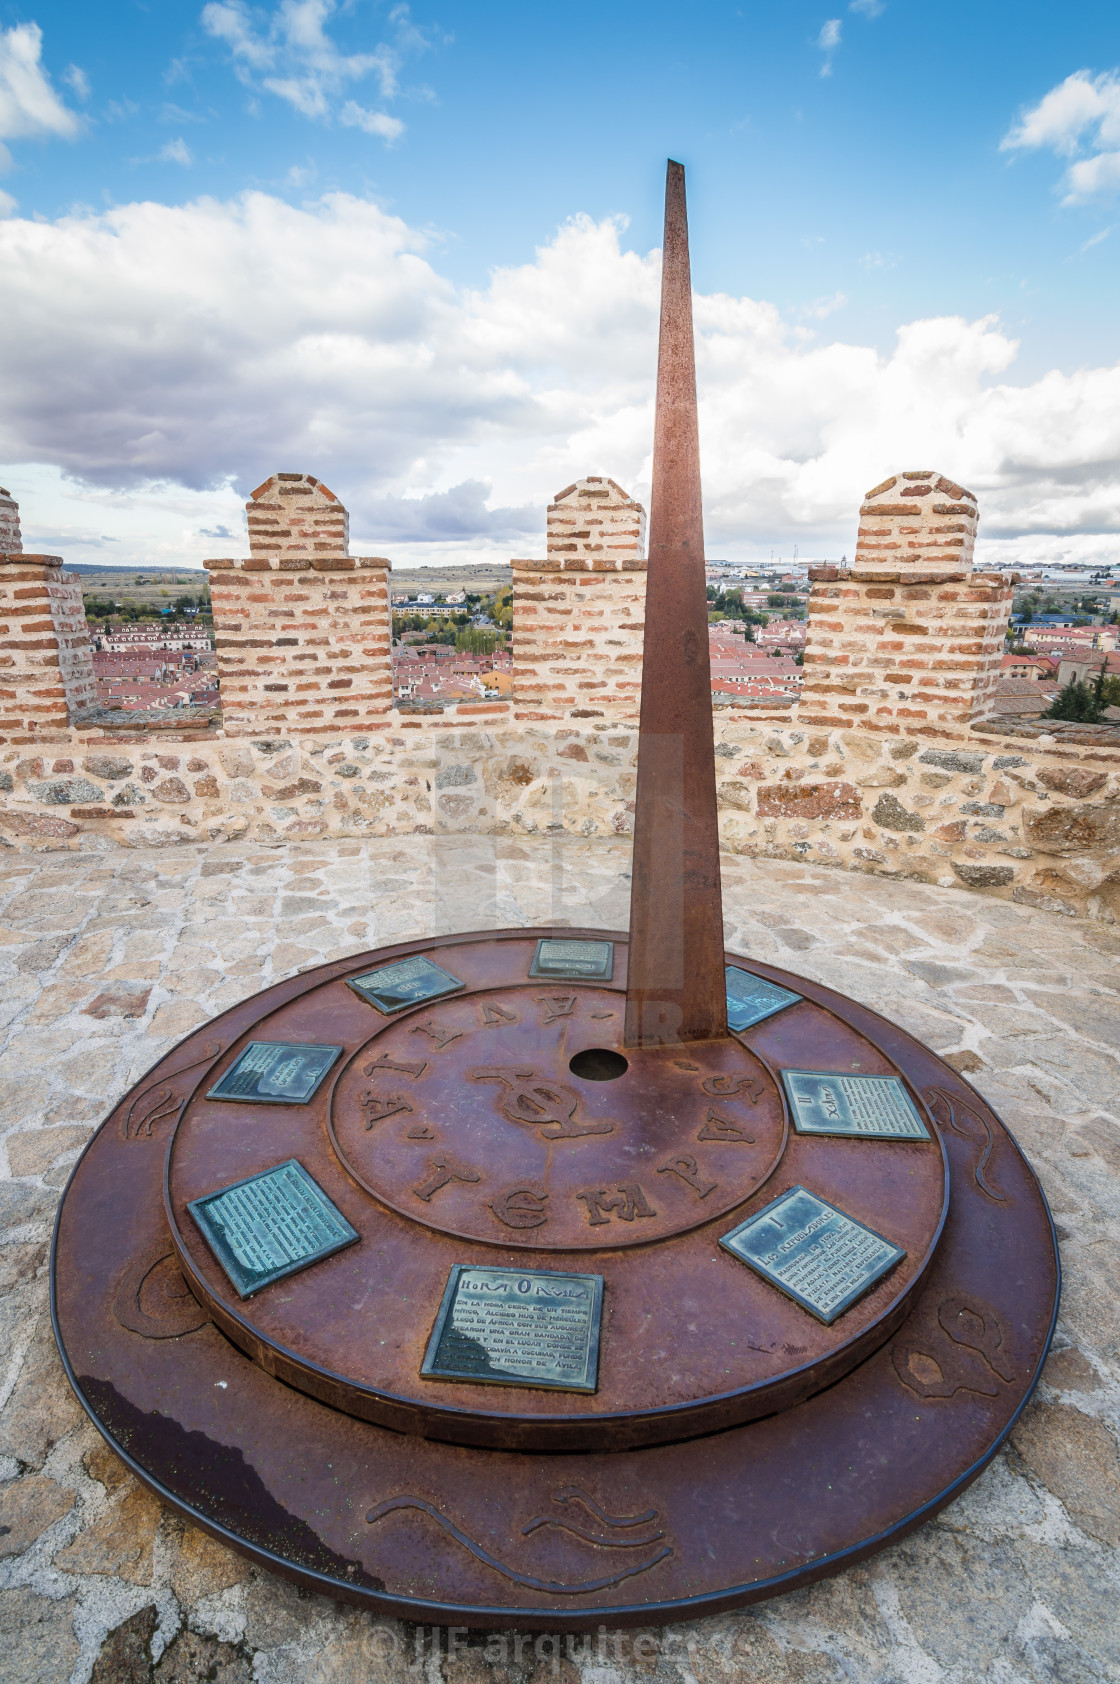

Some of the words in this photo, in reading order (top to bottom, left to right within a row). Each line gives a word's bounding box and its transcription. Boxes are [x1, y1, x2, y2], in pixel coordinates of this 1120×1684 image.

[768, 1216, 785, 1228] I
[825, 1241, 837, 1249] LAS
[829, 1241, 849, 1257] PUENTE
[798, 1285, 808, 1293] EL
[840, 1245, 857, 1258] DESDE
[813, 1295, 824, 1304] DE
[820, 1301, 831, 1310] DE
[827, 1293, 841, 1303] UNA
[838, 1283, 852, 1294] VIDA
[561, 1308, 587, 1316] TIEMPO
[534, 1332, 570, 1341] BANDADA
[504, 1357, 532, 1366] HONOR
